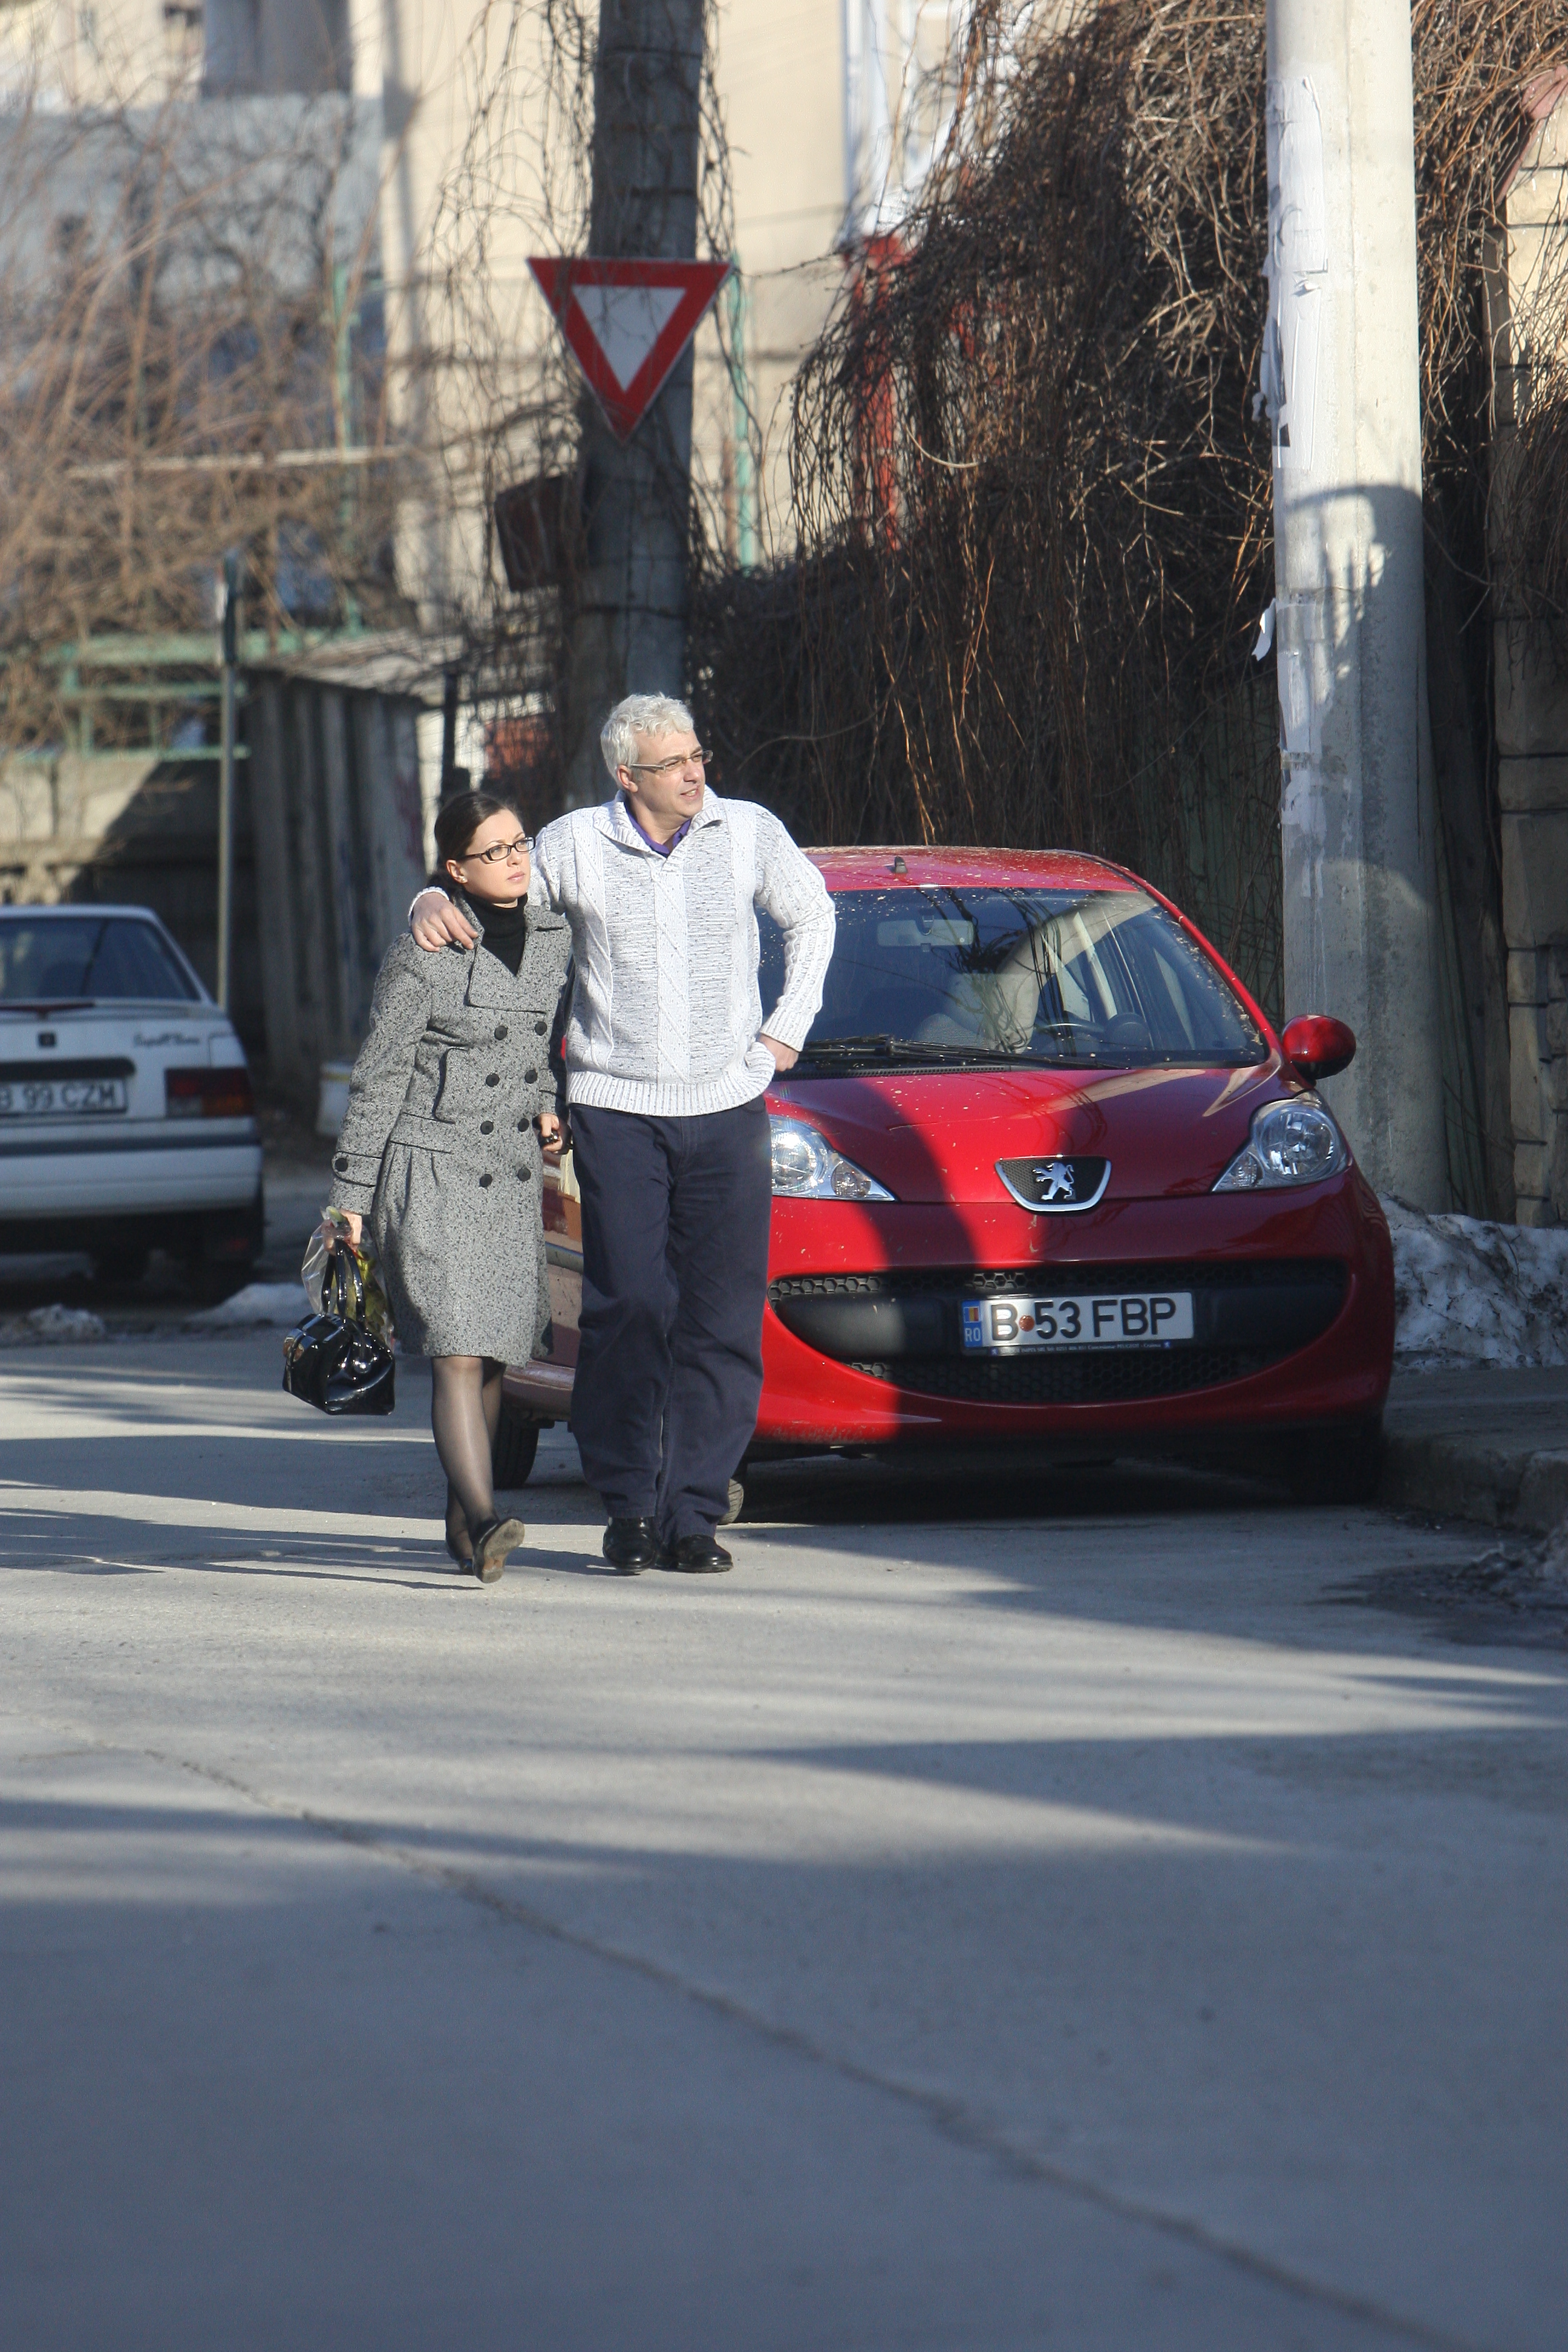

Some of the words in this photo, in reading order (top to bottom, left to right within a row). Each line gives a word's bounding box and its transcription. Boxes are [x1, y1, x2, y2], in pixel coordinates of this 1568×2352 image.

[23, 1082, 53, 1109] 99
[991, 1303, 1019, 1341] B
[1034, 1300, 1082, 1340] 53
[1092, 1297, 1176, 1338] FBP
[965, 1327, 981, 1342] RO
